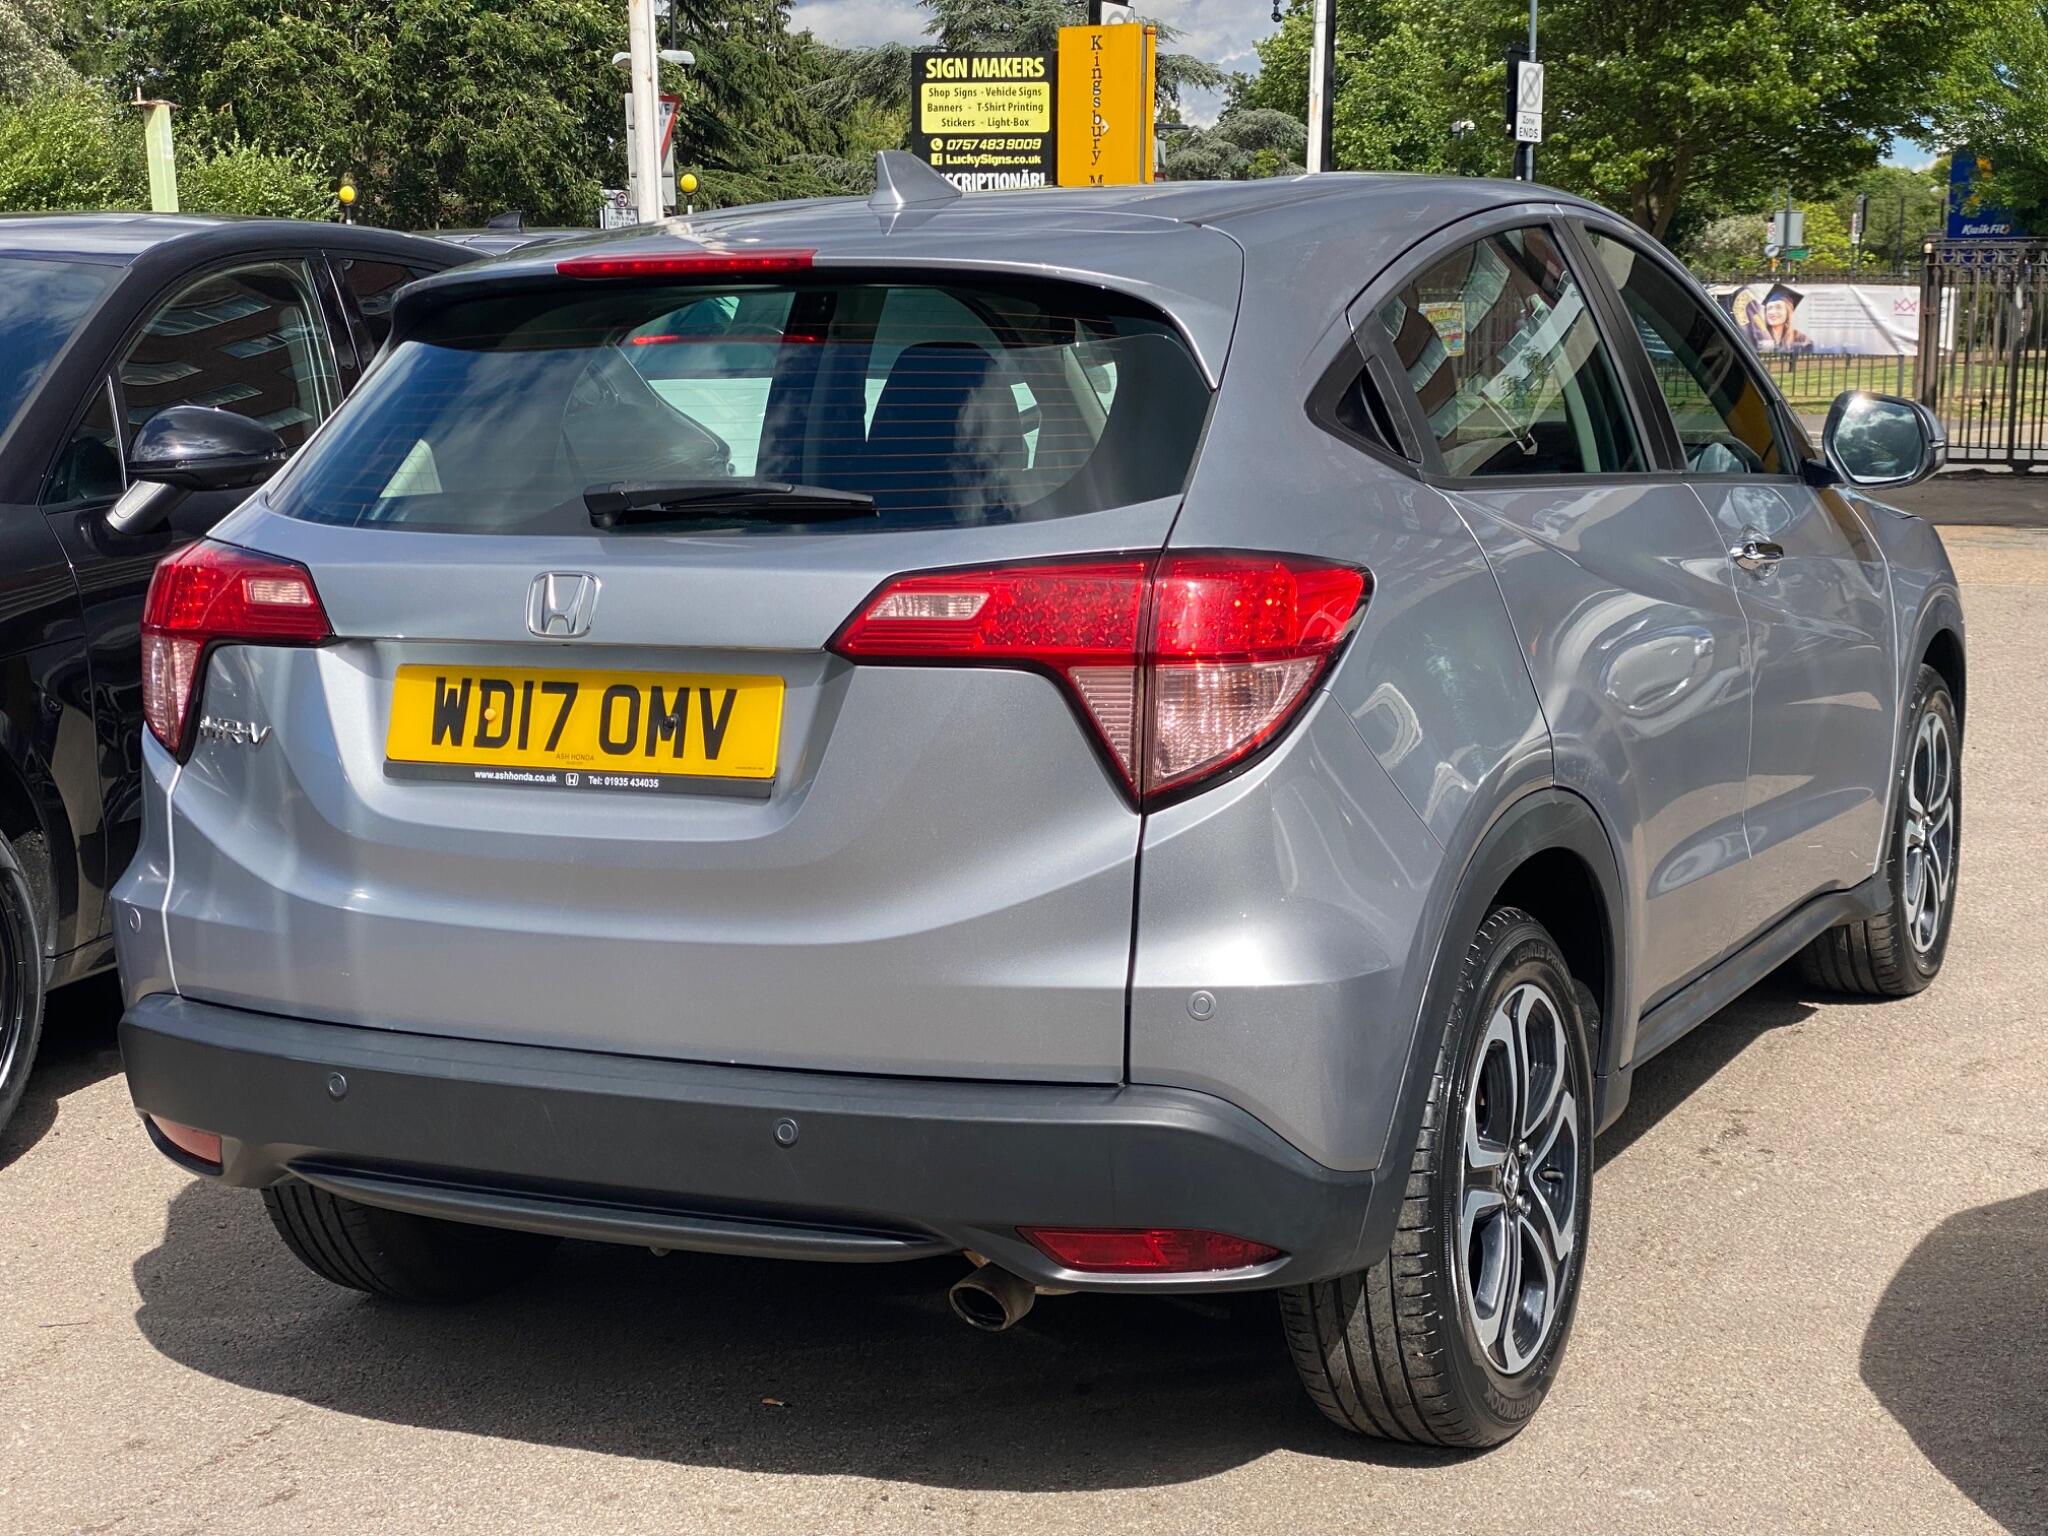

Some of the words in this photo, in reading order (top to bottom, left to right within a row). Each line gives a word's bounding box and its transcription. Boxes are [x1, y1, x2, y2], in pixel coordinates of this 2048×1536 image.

[925, 57, 968, 78] SIGN
[971, 57, 1045, 78] MAKERS
[928, 87, 951, 99] Shop
[954, 87, 977, 99] Signs
[985, 87, 1017, 97] Vehicle
[1018, 87, 1042, 99] Signs
[927, 103, 963, 112] Banners
[977, 102, 1006, 112] T-Shirt
[1008, 102, 1044, 113] Printing
[941, 118, 975, 127] Stickers
[987, 118, 1029, 128] Light-Box
[1521, 115, 1535, 125] Zone
[1519, 127, 1539, 138] ENDS
[946, 139, 979, 150] 0757
[979, 139, 1006, 150] 483
[1006, 138, 1042, 150] 9009
[946, 153, 1042, 168] LuckySigns.co.uk
[431, 676, 580, 752] WD17
[599, 684, 738, 761] OMV
[571, 753, 595, 761] HONDA
[474, 770, 557, 783] www.ashhonda.co.uk
[588, 775, 603, 786] Tel:
[604, 776, 628, 787] 01935
[630, 777, 659, 788] 434035
